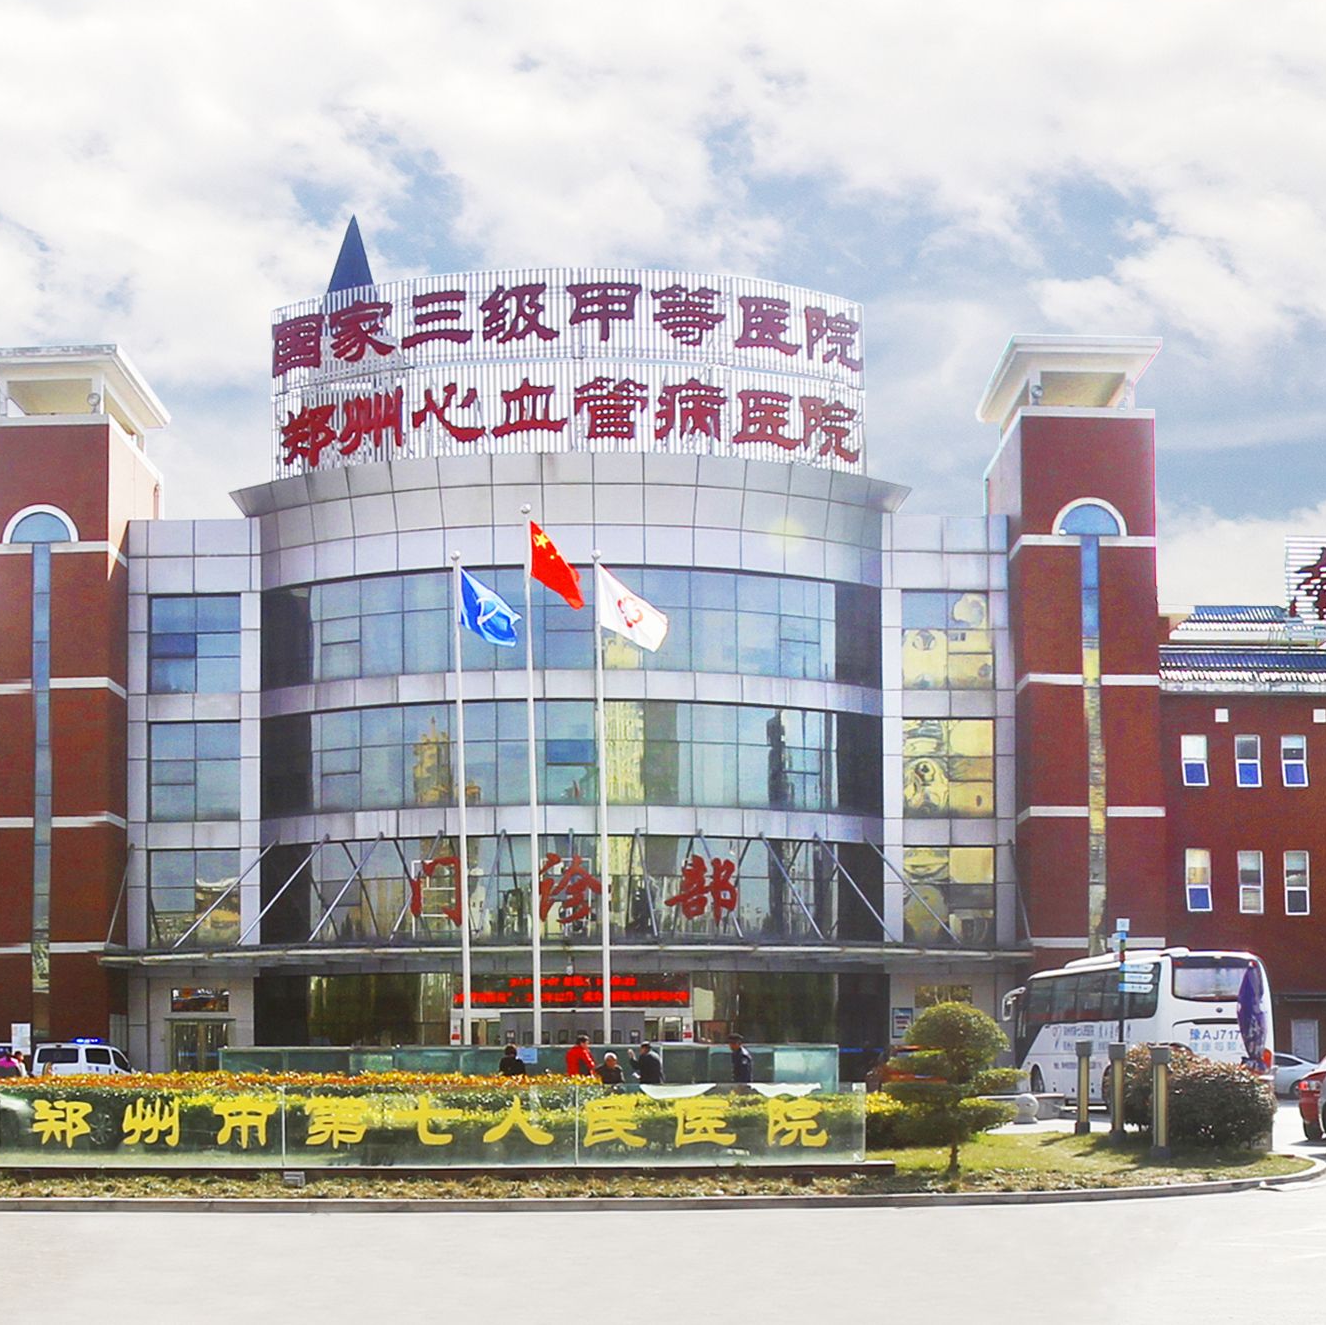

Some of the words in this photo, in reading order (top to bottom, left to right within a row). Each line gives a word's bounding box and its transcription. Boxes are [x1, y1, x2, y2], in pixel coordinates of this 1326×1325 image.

[273, 281, 864, 377] 国家三级甲等医院
[280, 376, 860, 467] 郑州心血管病医院
[411, 853, 737, 926] 门诊部
[1190, 1028, 1243, 1041] 豫AJ717
[31, 1095, 829, 1150] 郑州市第七人民医院
